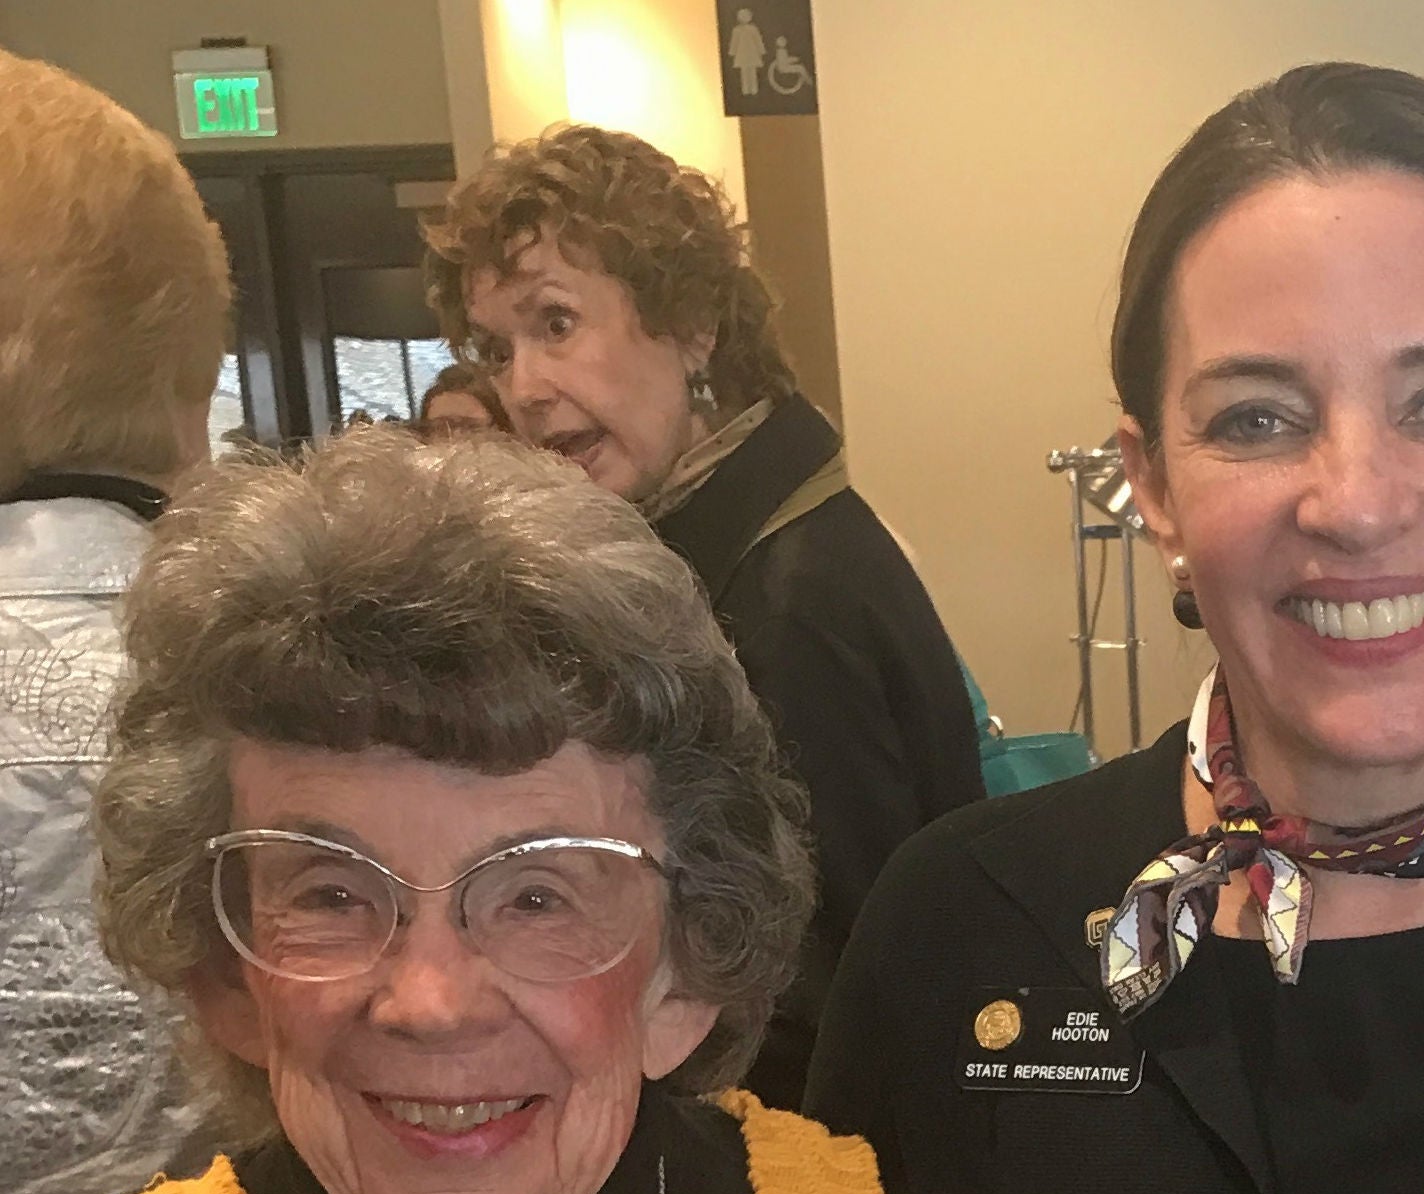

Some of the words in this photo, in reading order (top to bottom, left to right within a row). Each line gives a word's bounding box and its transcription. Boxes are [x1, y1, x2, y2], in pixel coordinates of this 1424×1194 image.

[194, 77, 259, 132] EXIT
[1066, 1011, 1100, 1026] EDIE
[1051, 1027, 1110, 1042] HOOTON
[965, 1063, 1008, 1079] STATE
[1013, 1065, 1130, 1082] REPRESENTATIVE
